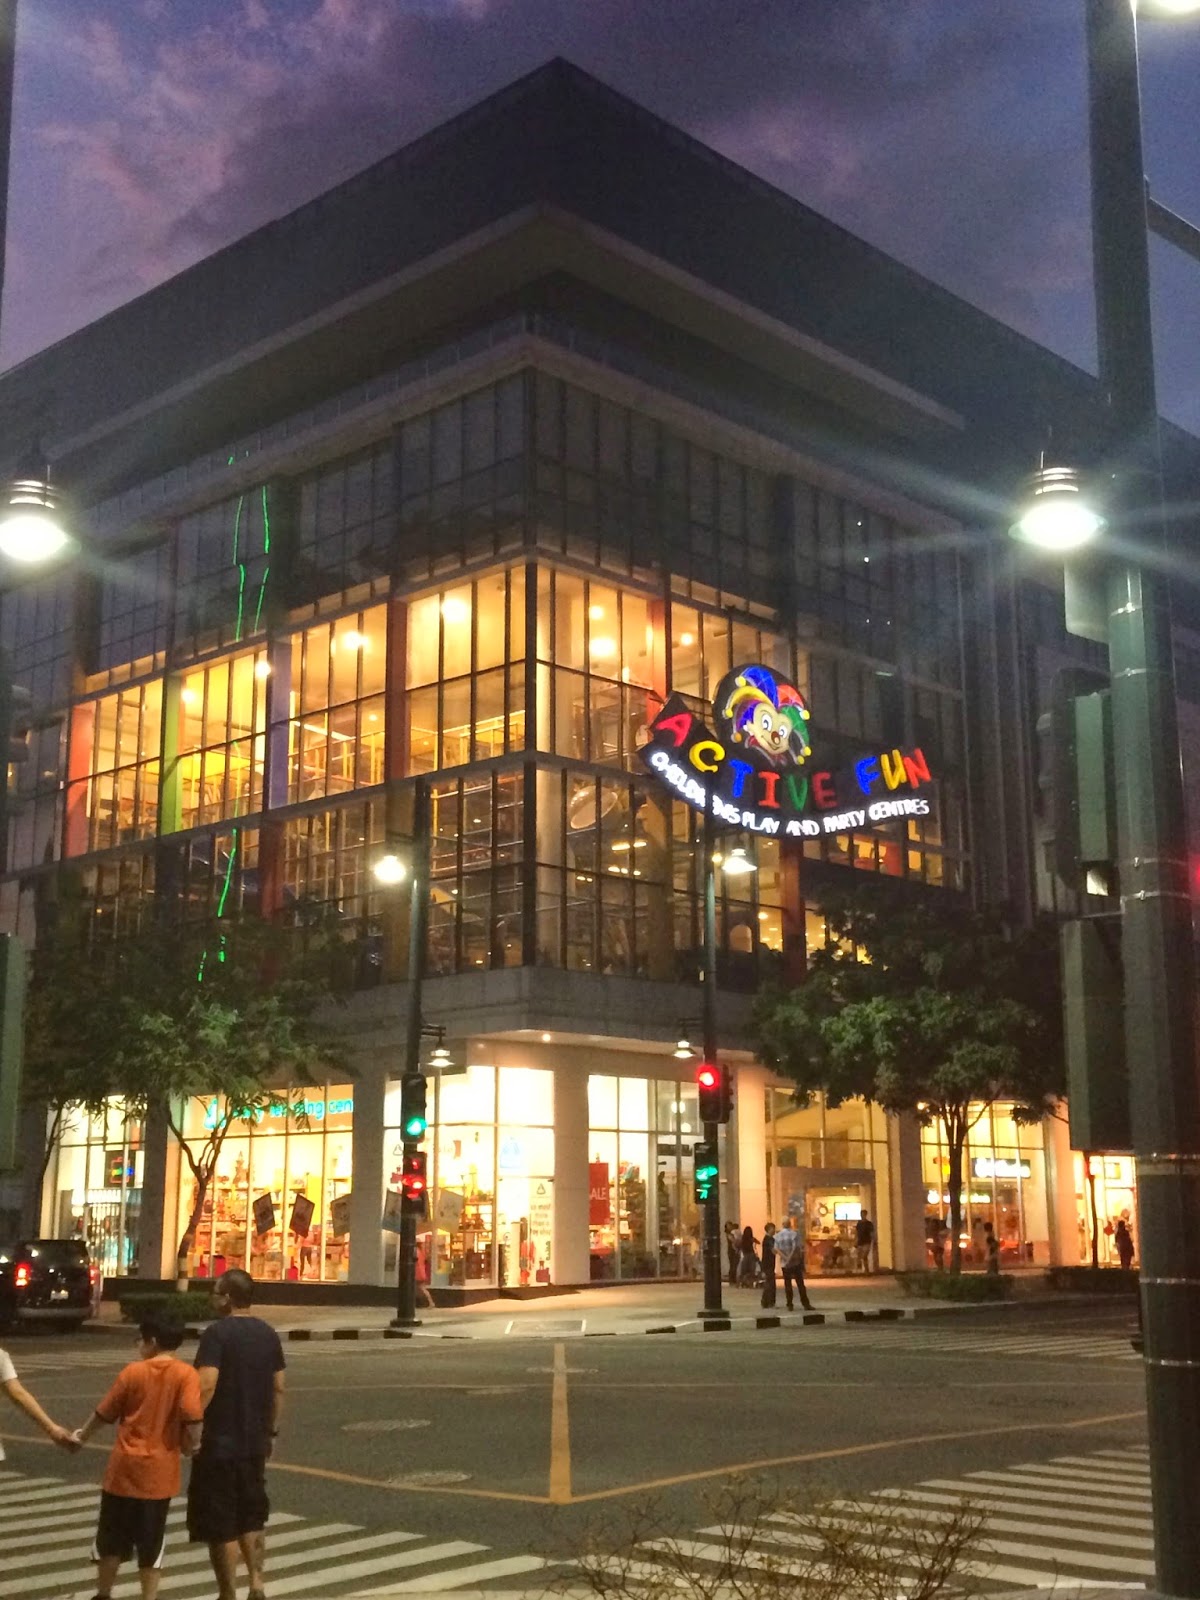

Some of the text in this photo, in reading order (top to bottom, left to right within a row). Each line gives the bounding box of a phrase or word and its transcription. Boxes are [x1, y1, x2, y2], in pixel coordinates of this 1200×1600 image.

[656, 712, 932, 811] ACTIVE FUN
[742, 812, 780, 833] PLAY
[786, 819, 820, 836] AND
[823, 810, 865, 833] PARTY
[869, 799, 930, 820] CENTRES
